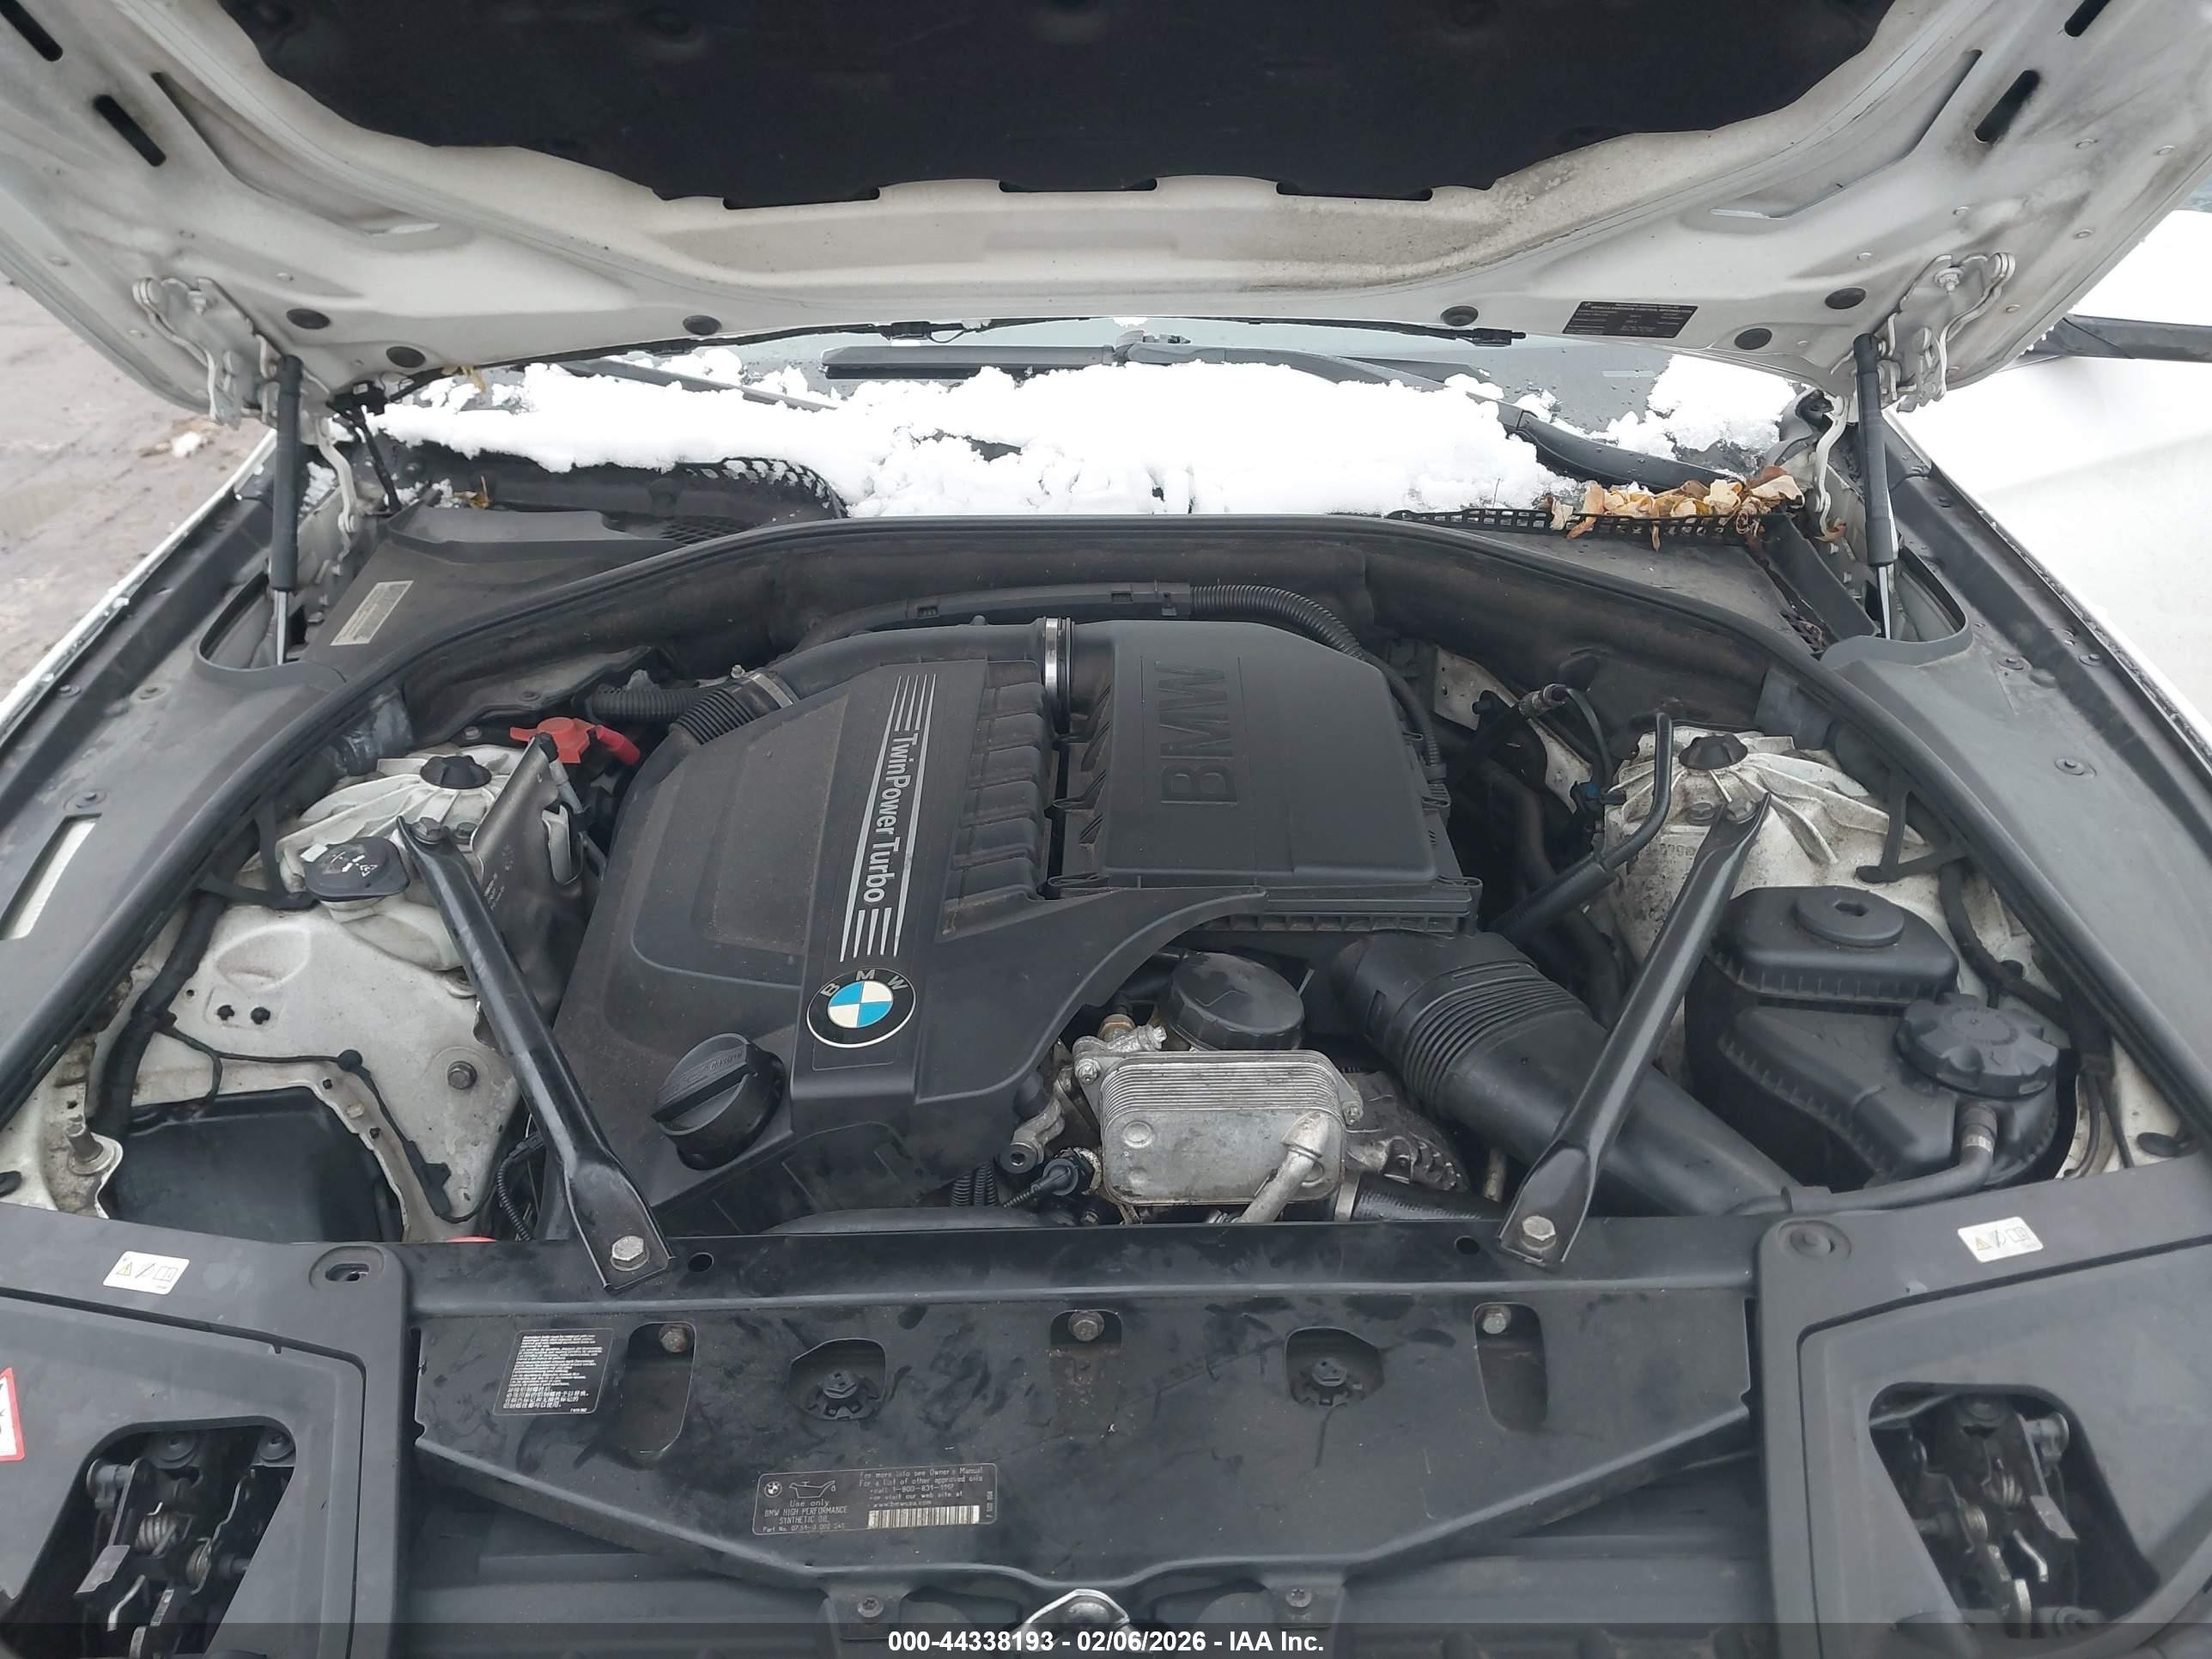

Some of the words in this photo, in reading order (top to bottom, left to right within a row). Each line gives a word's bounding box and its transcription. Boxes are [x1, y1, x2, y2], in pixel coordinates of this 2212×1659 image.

[1154, 659, 1238, 805] BMW
[874, 732, 919, 835] TwinPower
[863, 836, 901, 903] Turbo
[820, 969, 909, 997] BMW
[782, 1508, 799, 1516] HIGH
[802, 1505, 848, 1516] PERFORMANCE
[811, 1498, 830, 1508] only
[779, 1516, 814, 1526] SYNTHETIC
